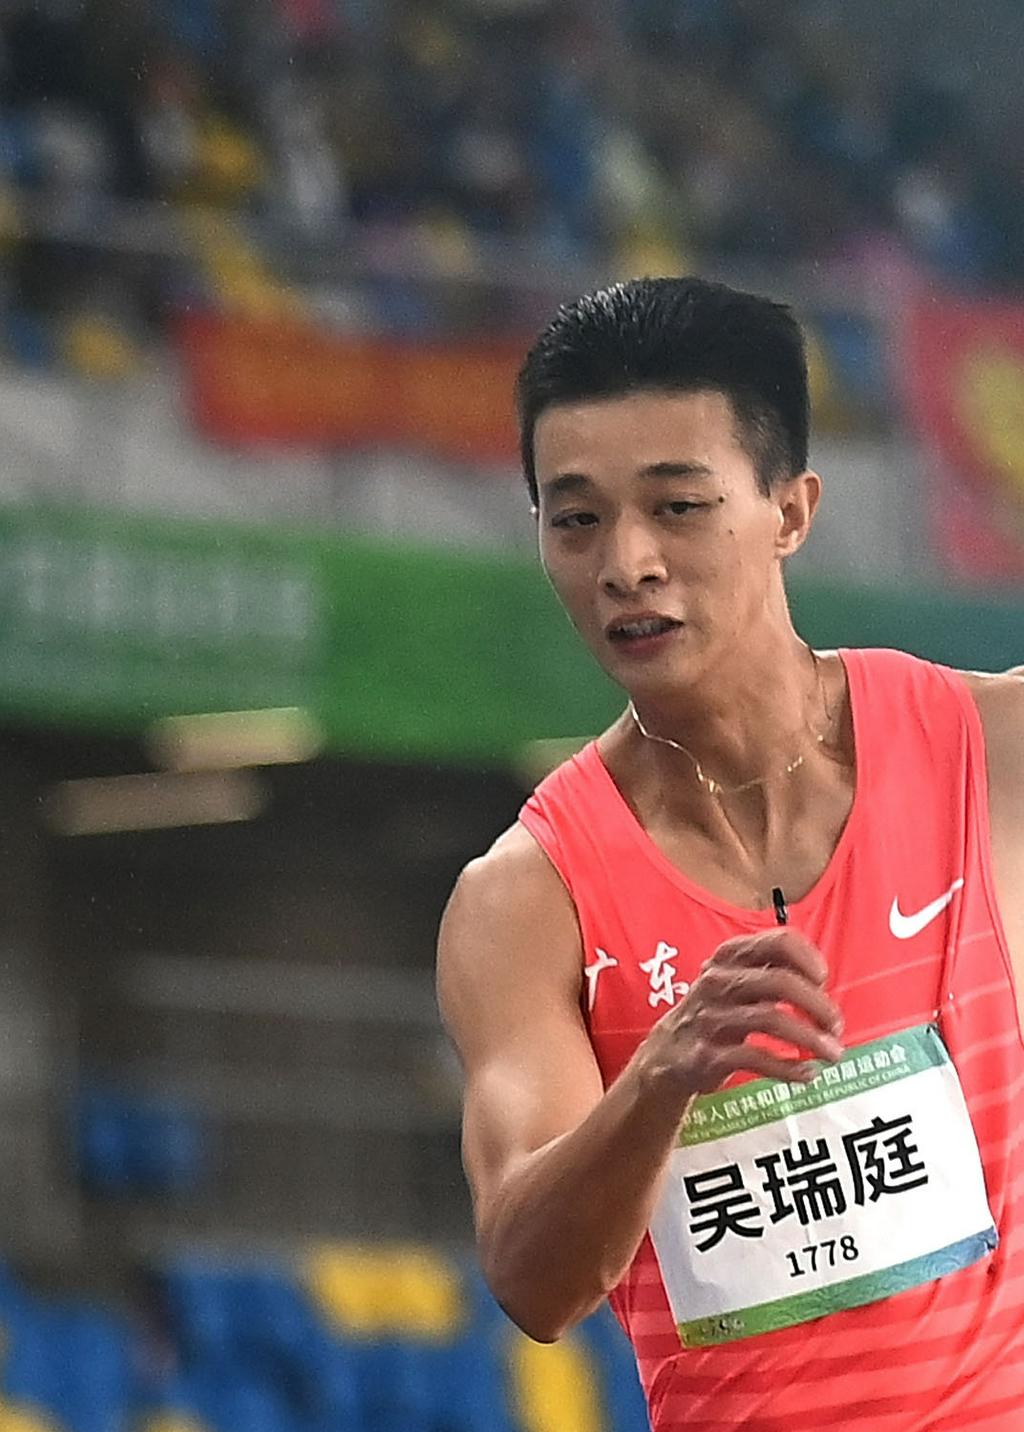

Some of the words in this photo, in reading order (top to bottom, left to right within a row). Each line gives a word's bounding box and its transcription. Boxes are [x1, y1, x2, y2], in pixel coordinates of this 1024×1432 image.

[584, 941, 690, 1012] 广东
[683, 1113, 929, 1253] 吴瑞庭
[785, 1235, 859, 1278] 1778
